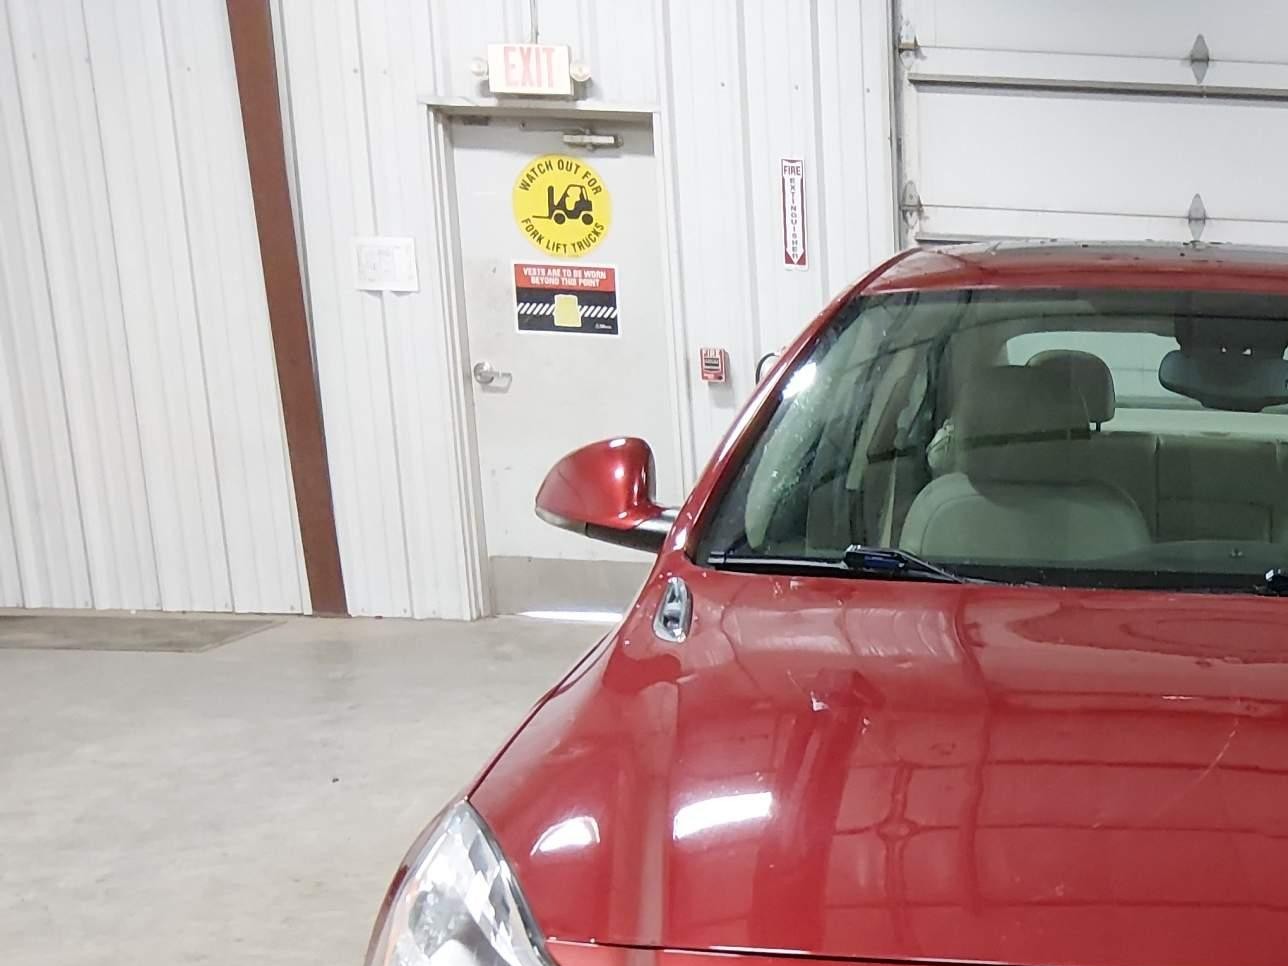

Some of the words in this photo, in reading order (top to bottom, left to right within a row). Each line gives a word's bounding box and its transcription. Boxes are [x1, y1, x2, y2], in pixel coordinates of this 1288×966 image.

[503, 46, 555, 88] EXIT
[519, 160, 553, 191] WATCH
[557, 159, 580, 175] OUT
[582, 171, 602, 195] FOR
[783, 165, 801, 176] FIRE
[521, 218, 544, 245] FORK
[546, 239, 567, 254] LIFT
[571, 222, 605, 253] TRUCKS
[789, 177, 798, 259] EXTINGUISHER
[523, 267, 546, 276] VESTS
[547, 268, 561, 277] ARE
[562, 269, 572, 277] TO
[573, 269, 582, 278] BE
[583, 270, 607, 279] WORN
[530, 276, 559, 286] BEYOND
[561, 277, 577, 286] THIS
[578, 278, 600, 287] POINT
